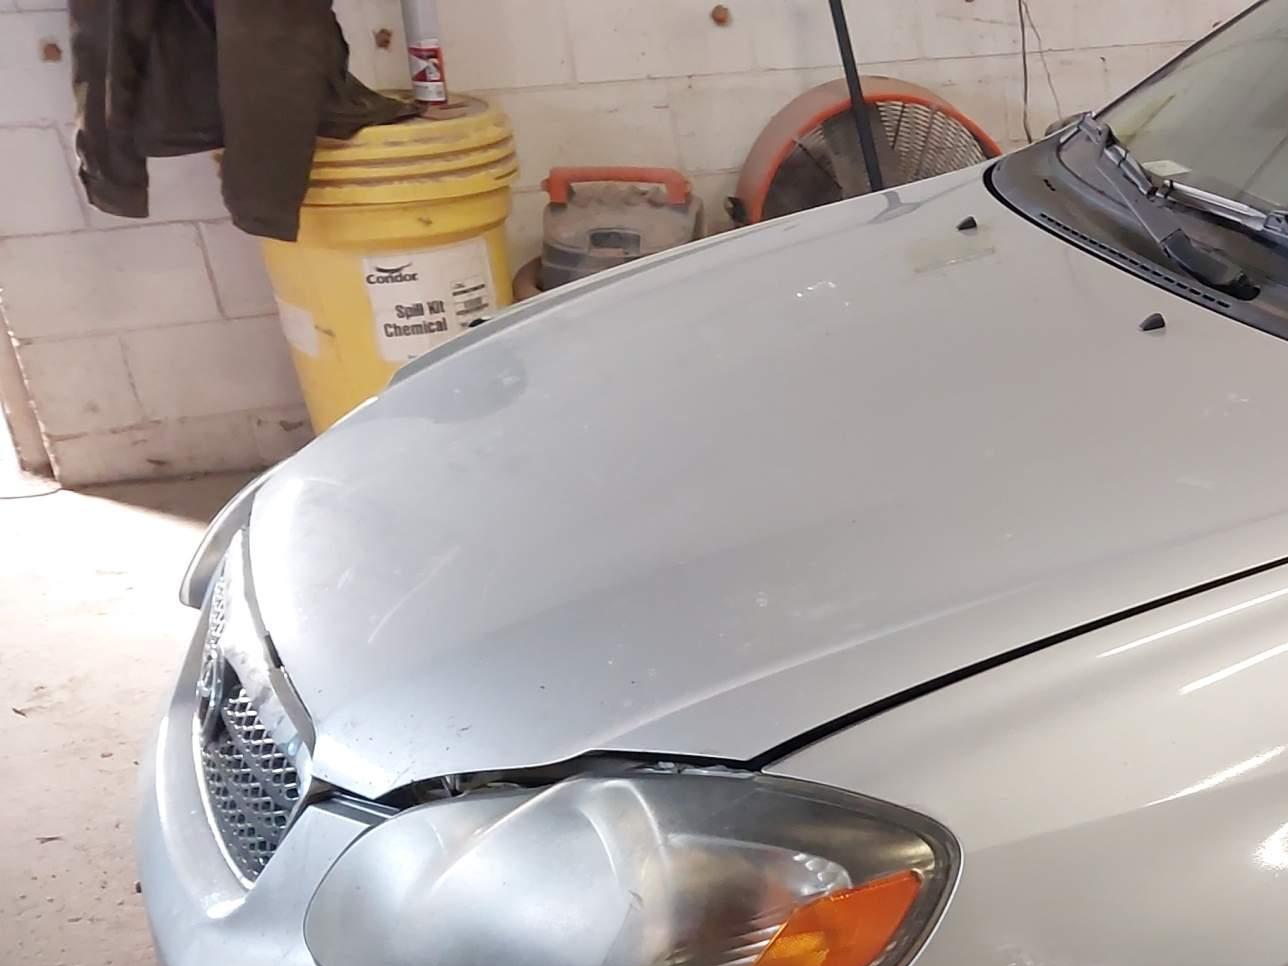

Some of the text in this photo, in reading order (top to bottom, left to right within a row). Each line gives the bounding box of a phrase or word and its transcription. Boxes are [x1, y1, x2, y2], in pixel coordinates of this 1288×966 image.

[366, 271, 418, 284] Condor
[394, 301, 424, 319] Spill
[427, 299, 446, 315] Kit
[384, 317, 448, 337] Chemical
